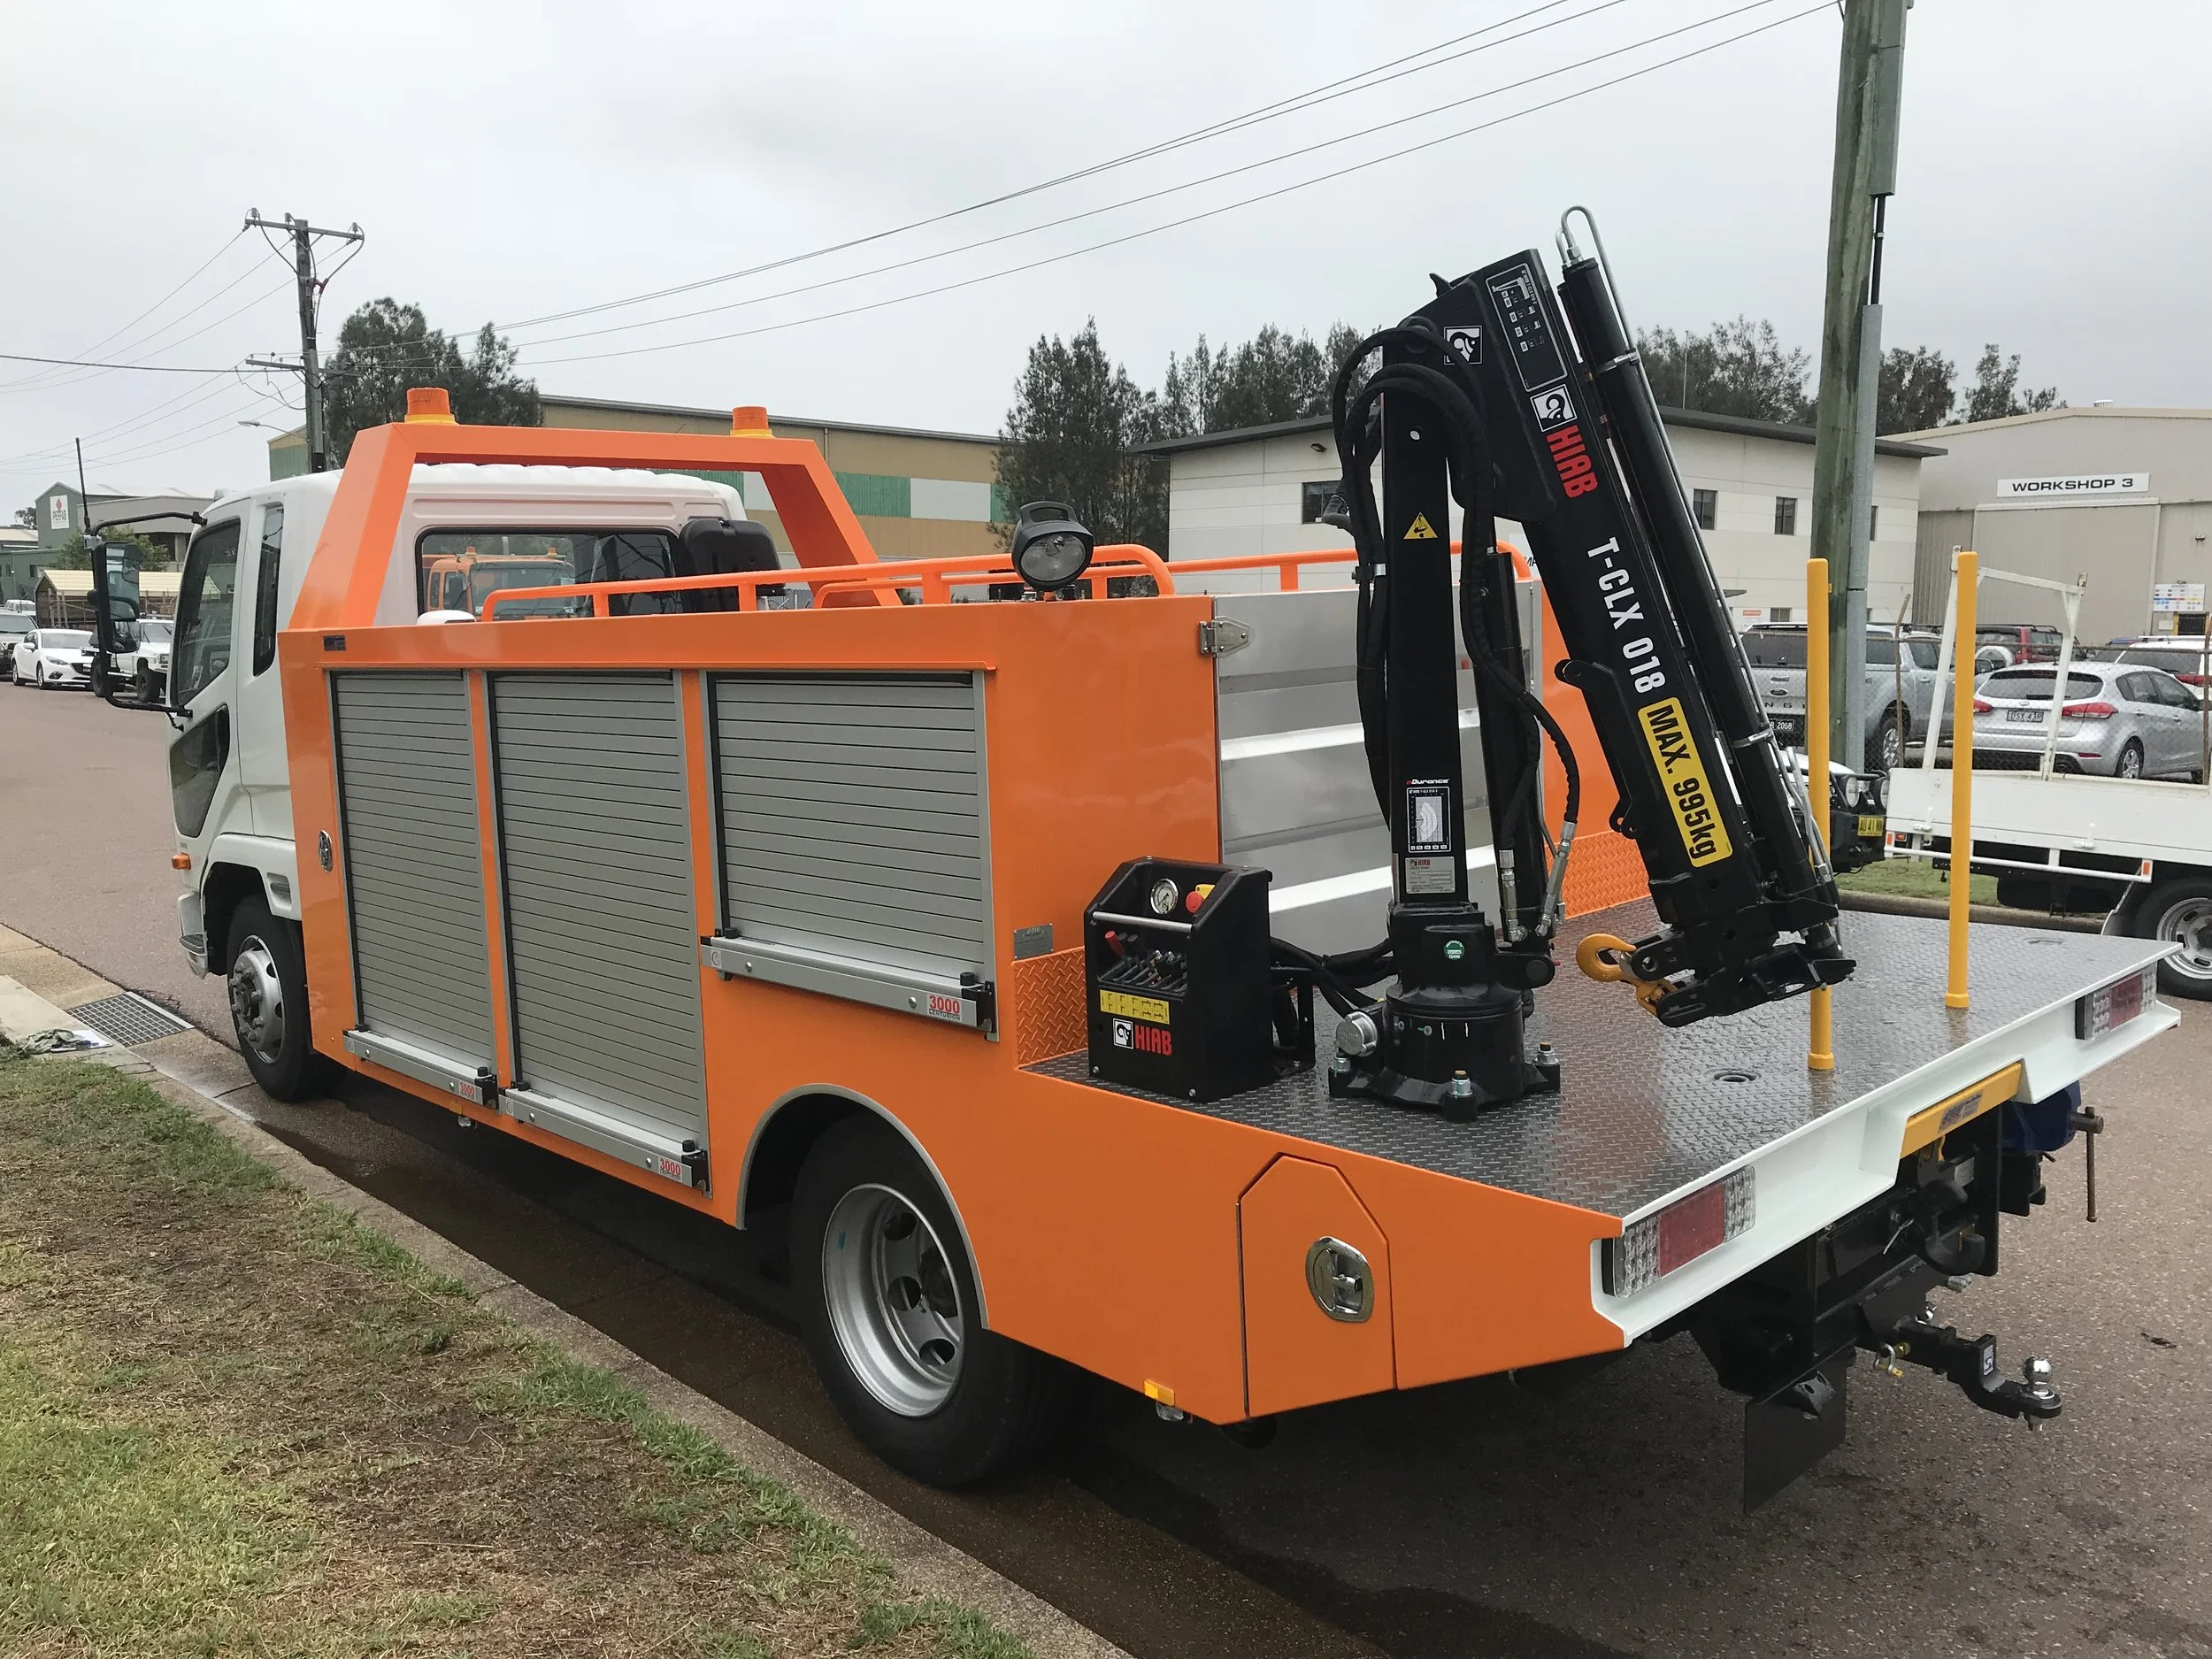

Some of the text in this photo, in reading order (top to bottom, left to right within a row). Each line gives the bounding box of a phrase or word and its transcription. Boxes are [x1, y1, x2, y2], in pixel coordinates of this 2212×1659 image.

[1547, 425, 1598, 498] HIAB
[2012, 479, 2133, 492] WORKSHOP 3
[1587, 536, 1665, 693] T-CLX 018
[1647, 704, 1717, 859] MAX. 995kg
[928, 1009, 961, 1021] CENTURION
[929, 995, 960, 1015] 3000
[1135, 1025, 1172, 1056] HIAB
[659, 1158, 681, 1176] 3000
